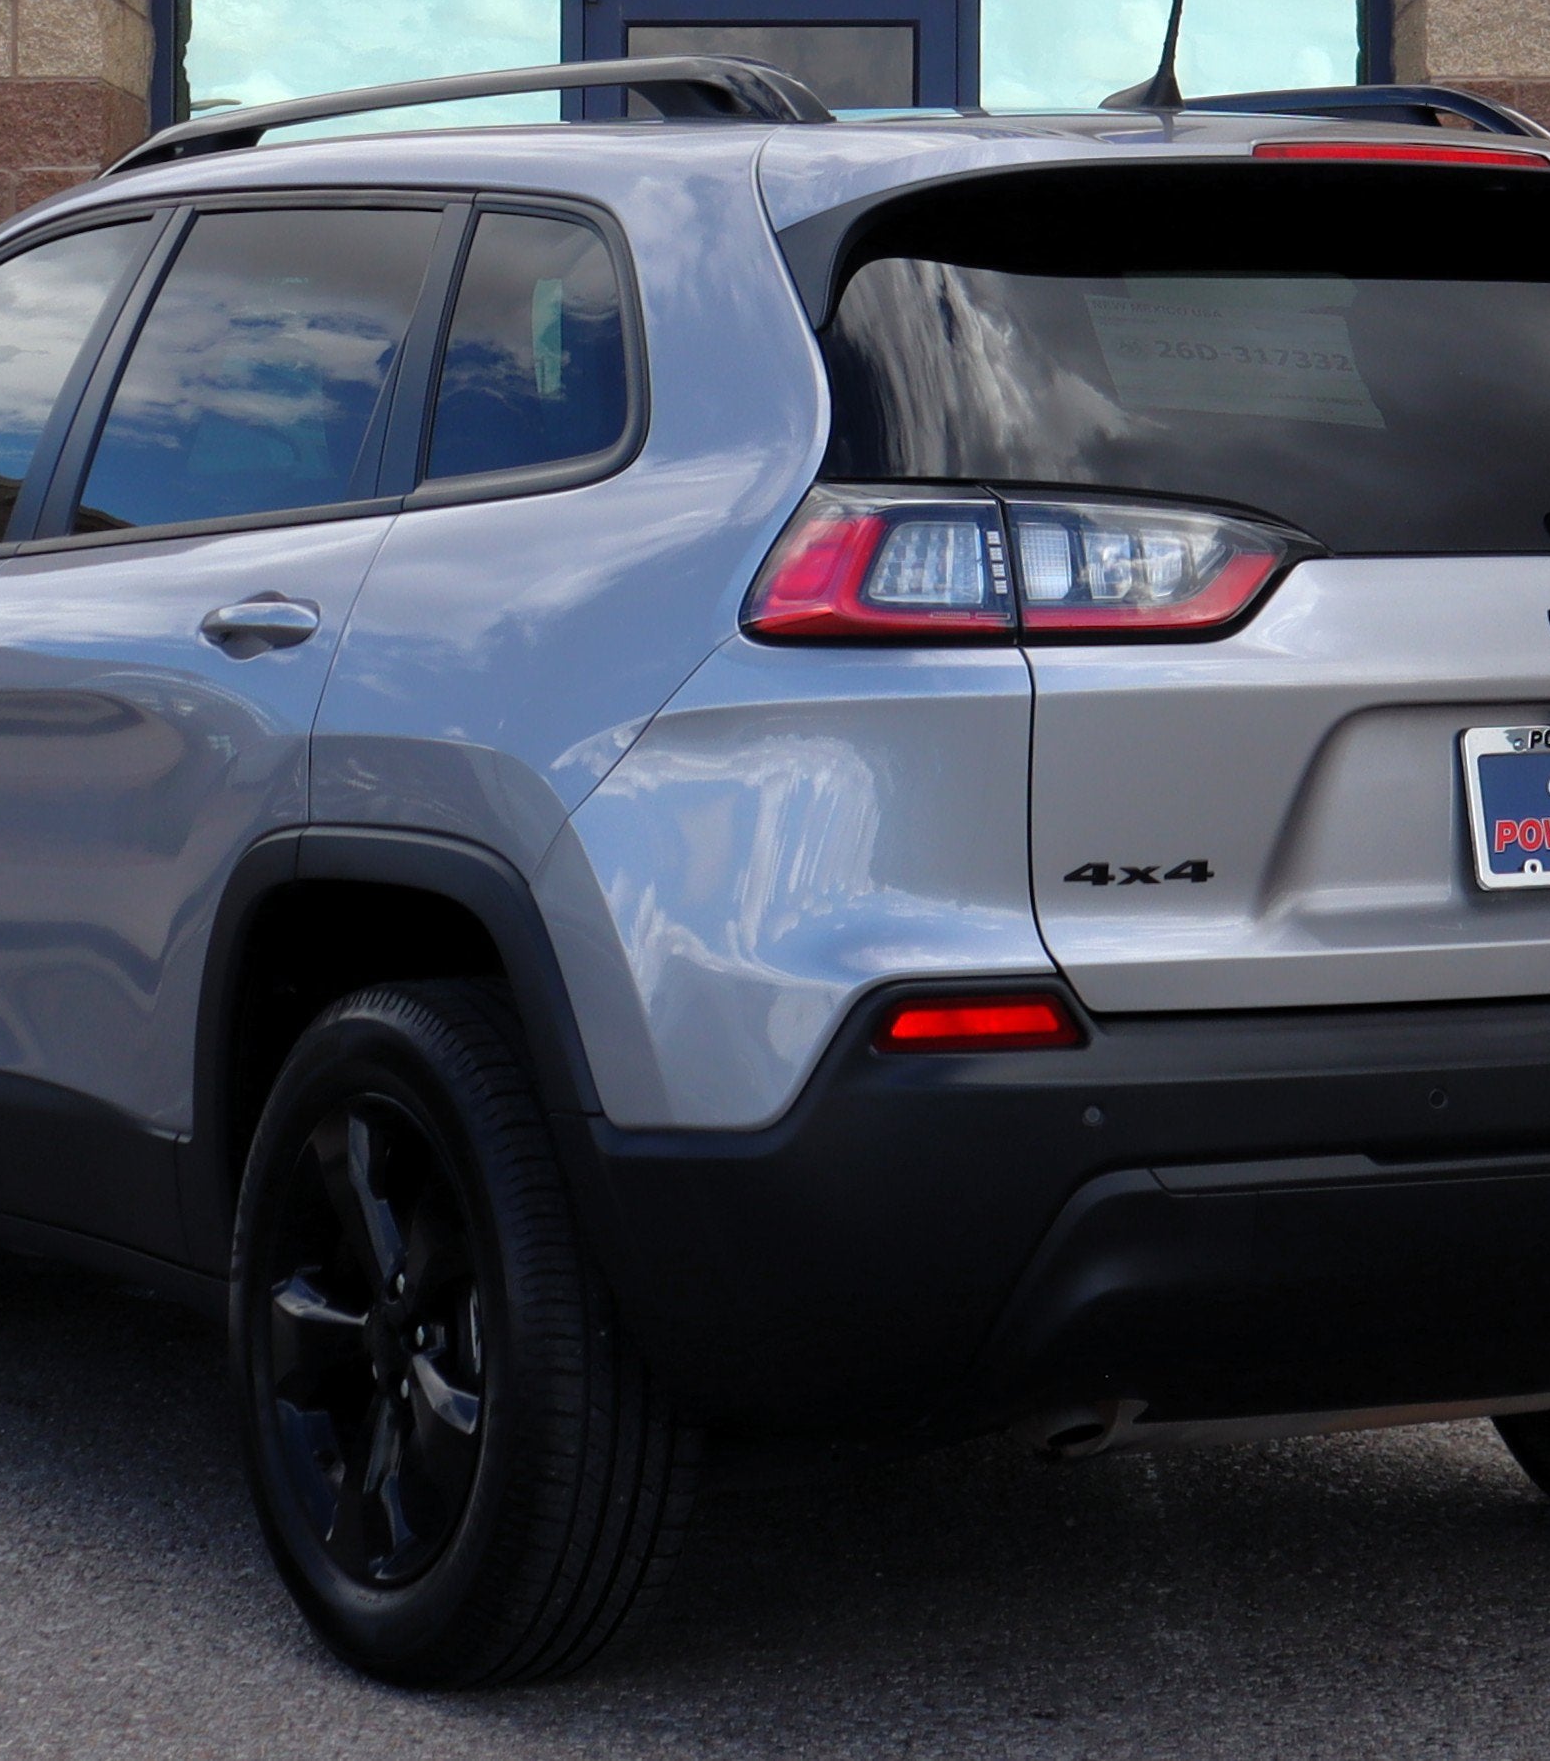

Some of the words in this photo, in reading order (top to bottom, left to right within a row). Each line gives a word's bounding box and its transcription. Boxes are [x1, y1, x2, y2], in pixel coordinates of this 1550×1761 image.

[1091, 300, 1127, 312] NEW
[1130, 303, 1187, 316] MEXICO
[1191, 308, 1223, 319] USA
[1063, 860, 1215, 886] 4x4
